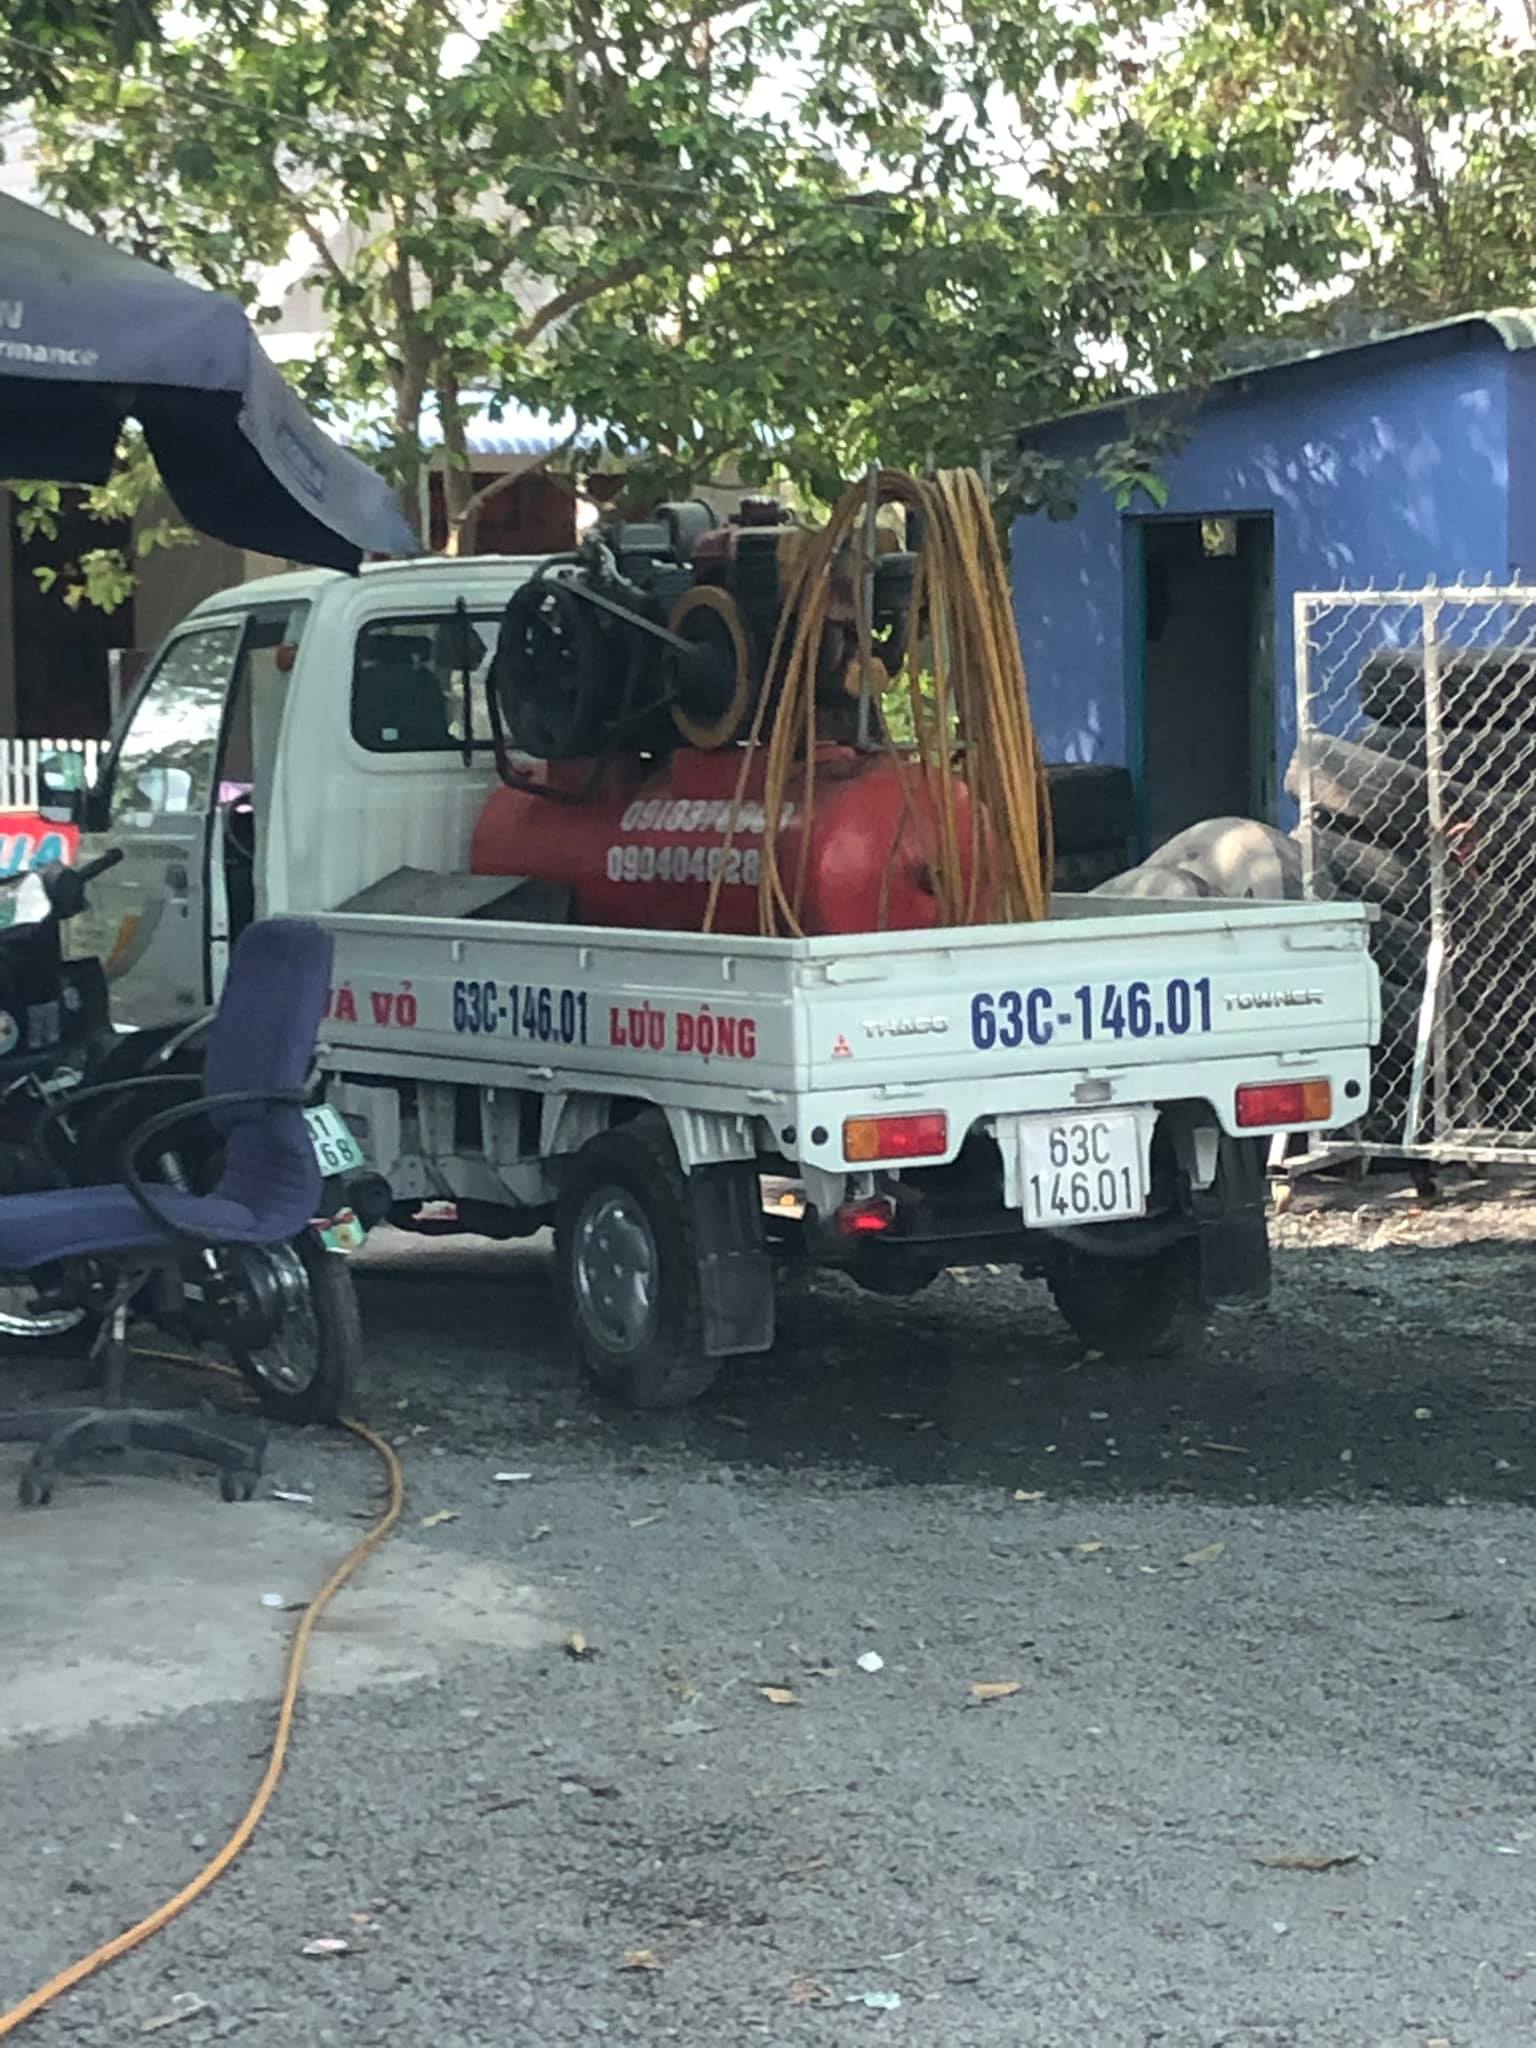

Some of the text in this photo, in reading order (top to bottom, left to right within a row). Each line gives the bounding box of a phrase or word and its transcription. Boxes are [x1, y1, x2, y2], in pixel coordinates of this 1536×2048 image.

[452, 979, 590, 1046] 63C-146.01
[969, 976, 1214, 1050] 63C-146.01
[1222, 987, 1325, 1012] TOWNER
[674, 1003, 758, 1064] ĐỘNG
[1048, 1122, 1112, 1168] 63C
[1029, 1166, 1135, 1219] 146.01
